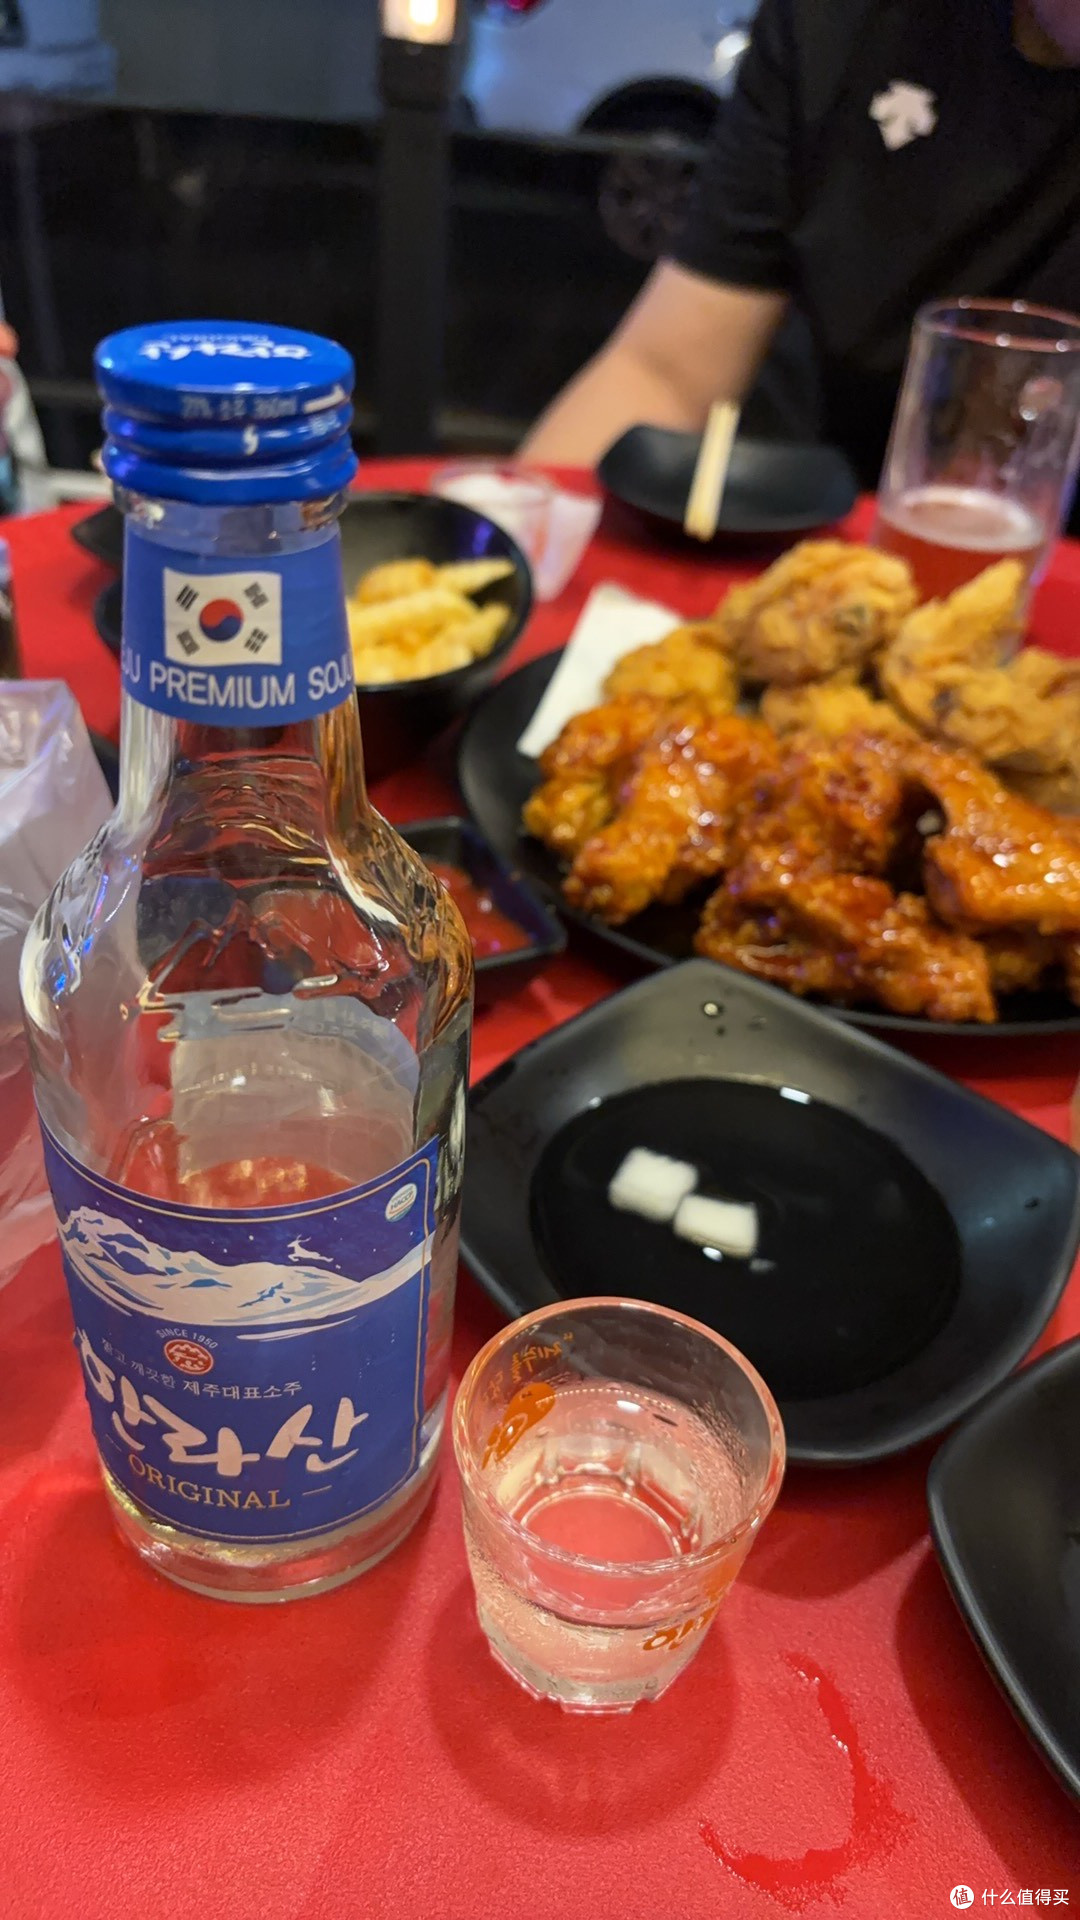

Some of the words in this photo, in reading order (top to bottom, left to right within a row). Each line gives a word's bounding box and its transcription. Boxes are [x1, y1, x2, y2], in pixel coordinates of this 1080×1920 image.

[150, 661, 295, 709] PREMIUM
[156, 1328, 188, 1340] SINCE
[193, 1332, 219, 1349] 1950
[75, 1325, 369, 1478] 한라산
[182, 1380, 303, 1401] 제주대표소주
[128, 1453, 292, 1510] ORIGINAL
